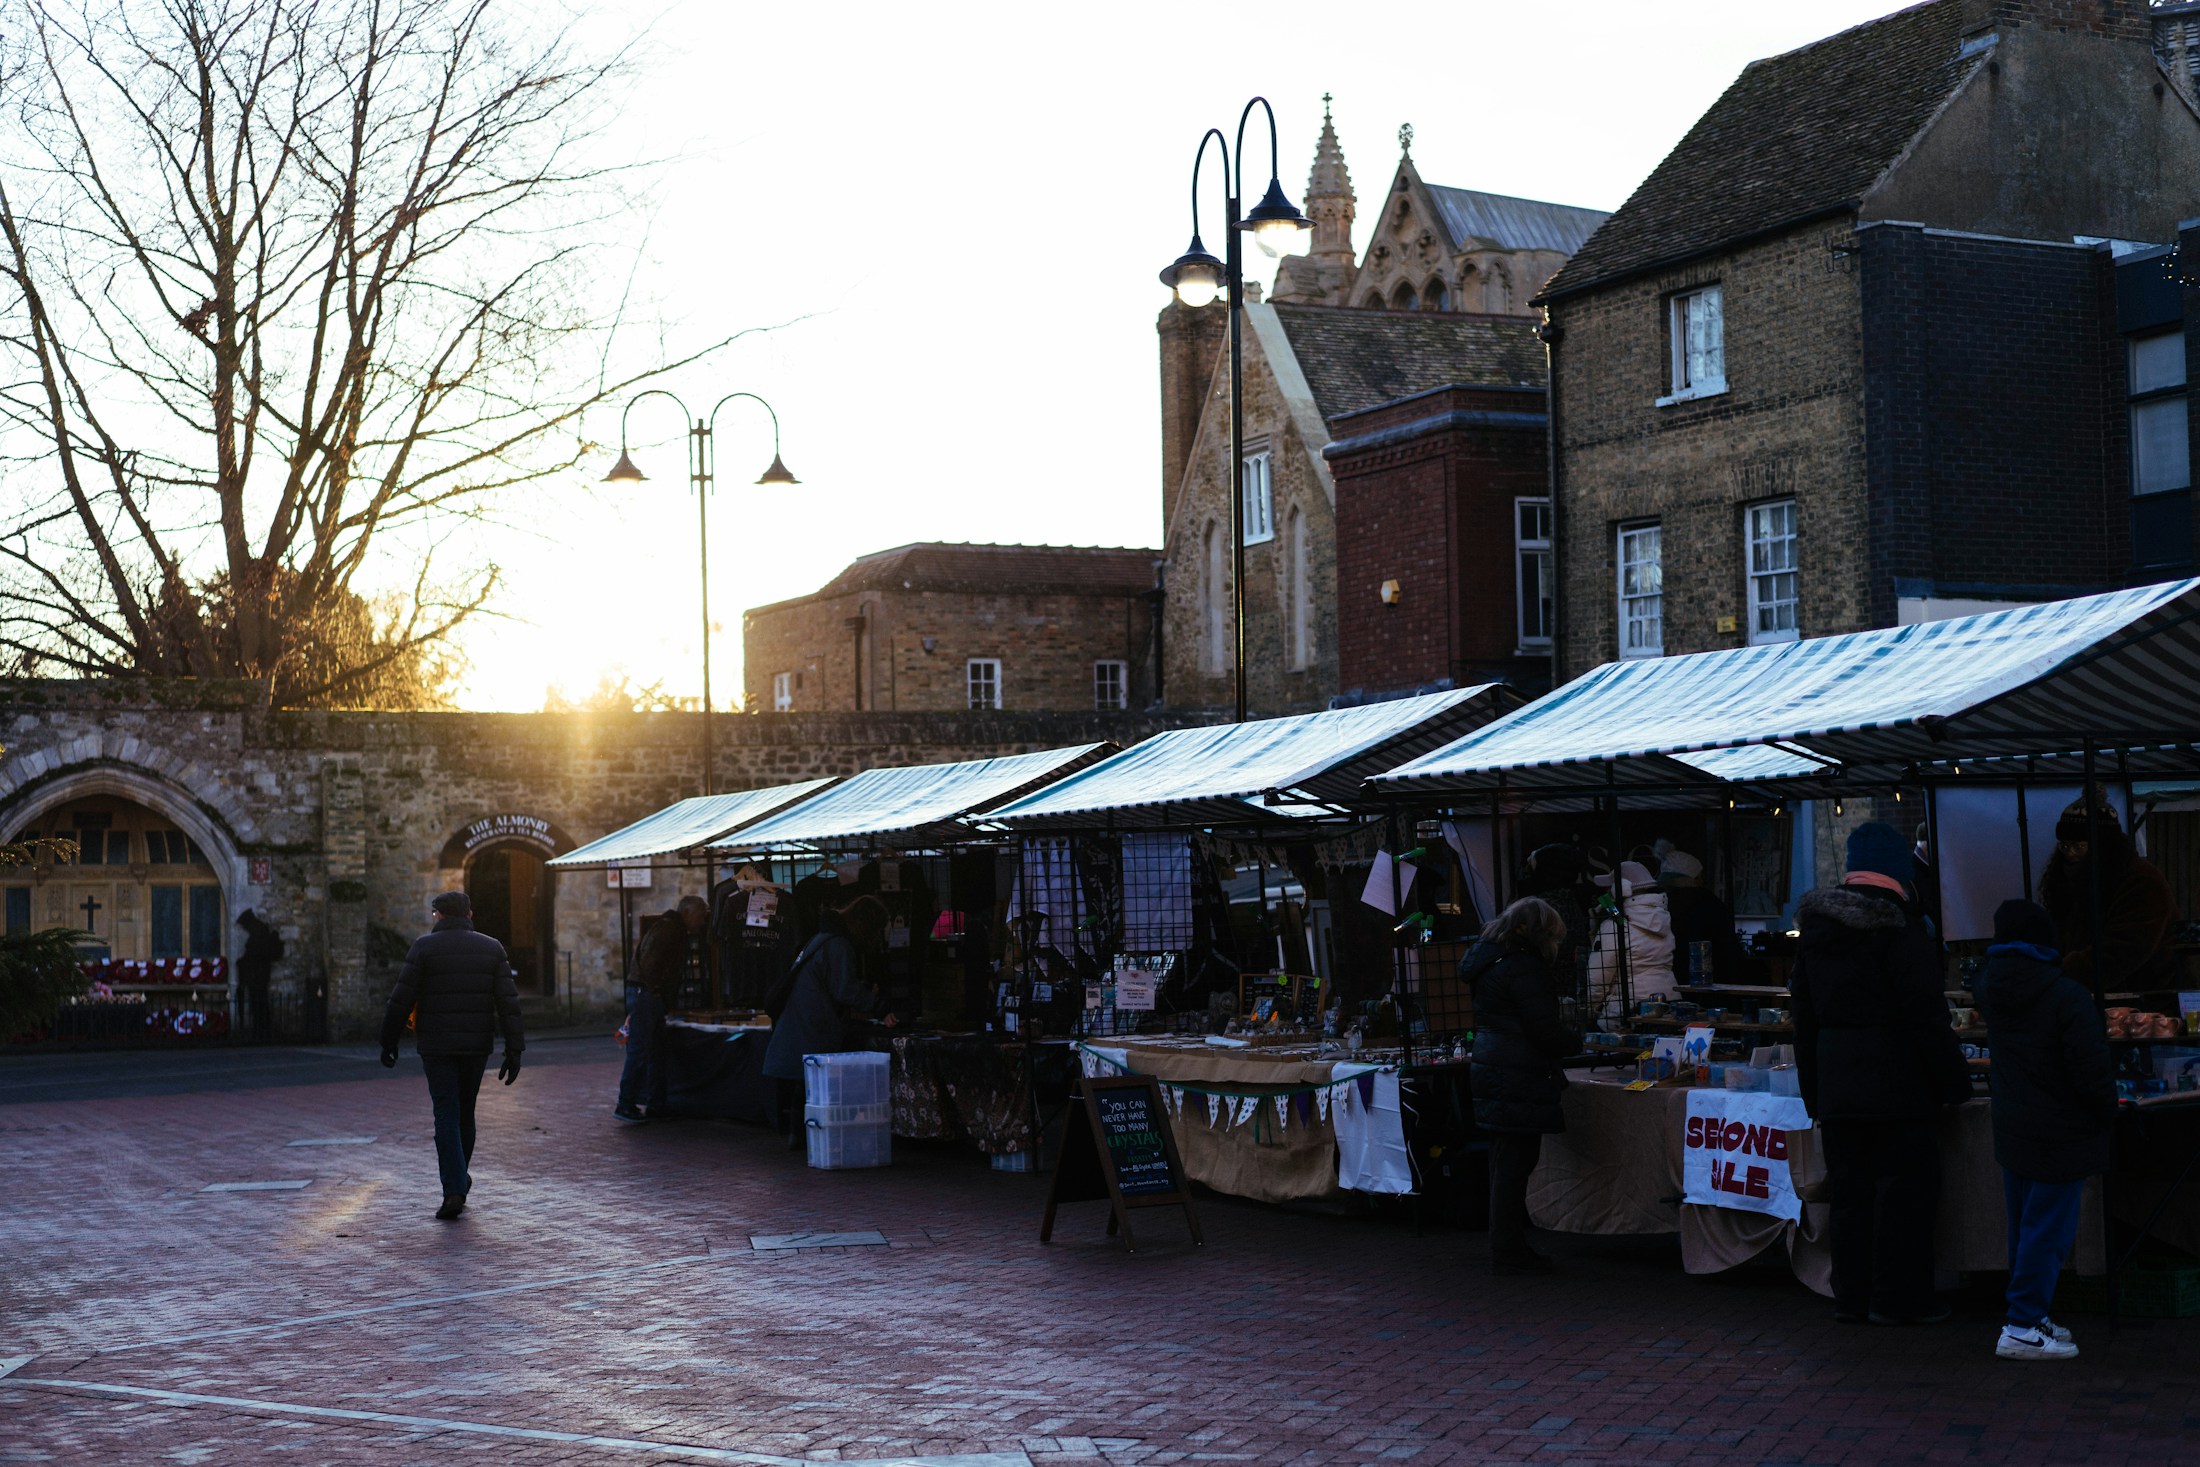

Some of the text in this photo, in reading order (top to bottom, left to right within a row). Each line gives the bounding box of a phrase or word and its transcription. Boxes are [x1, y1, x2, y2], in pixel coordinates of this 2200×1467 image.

[468, 815, 551, 835] THE ALMONRY
[1129, 1100, 1147, 1109] CAN
[1102, 1111, 1147, 1124] NEVER HAVE
[1111, 1122, 1149, 1134] TOO MANY
[1106, 1131, 1164, 1152] CRYSTALS
